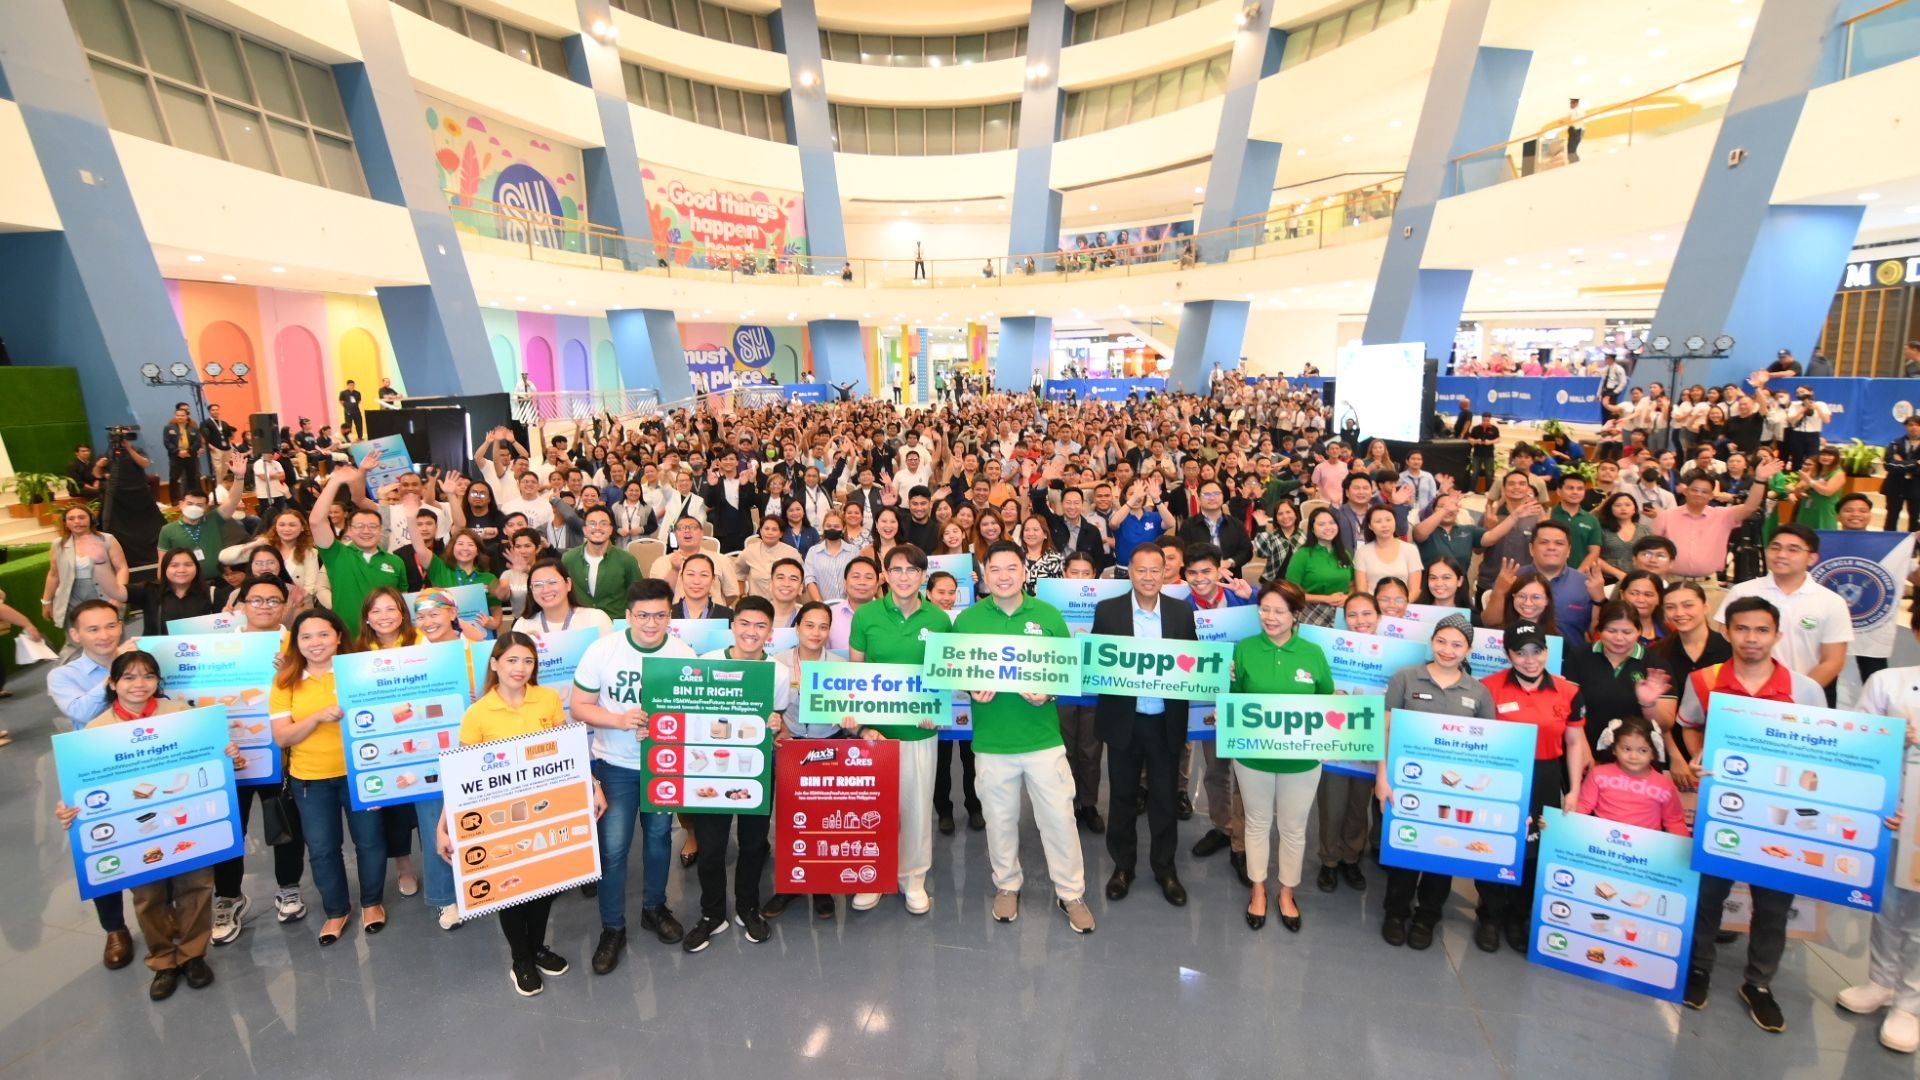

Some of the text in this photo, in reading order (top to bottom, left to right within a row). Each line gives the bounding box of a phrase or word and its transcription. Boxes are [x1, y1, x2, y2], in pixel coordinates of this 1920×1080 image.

[668, 180, 779, 223] Good things
[690, 209, 759, 241] happen
[1205, 632, 1227, 640] right!
[1516, 625, 1536, 635] KFC
[942, 646, 1079, 666] Be the Solution
[1083, 642, 1092, 665] I
[1471, 652, 1485, 661] Bin
[1487, 653, 1494, 661] it
[179, 663, 196, 672] Bin
[539, 657, 563, 668] right!
[1333, 656, 1348, 665] Bin
[1357, 662, 1383, 671] right!
[376, 673, 428, 687] Bin it right!
[616, 670, 642, 687] SP
[926, 662, 1070, 684] Join the Mission
[812, 672, 819, 691] I
[823, 676, 869, 692] care
[871, 673, 903, 692] for
[1082, 675, 1220, 694] #SMWasteFreeFuture
[608, 686, 642, 704] HA
[673, 686, 743, 697] BIN IT RIGHT!
[809, 694, 943, 715] Environment
[1226, 702, 1234, 728] I
[1442, 723, 1464, 732] KFC
[131, 734, 159, 744] CARES
[1227, 738, 1375, 752] #SMWasteFreeFuture
[1434, 737, 1451, 746] Bin
[1461, 741, 1488, 751] right!
[1765, 728, 1838, 747] Bin it right!
[114, 742, 178, 762] Bin it right!
[481, 760, 511, 772] CARES
[844, 758, 873, 766] CARES
[461, 780, 484, 795] WE
[489, 773, 512, 789] BIN
[516, 769, 528, 782] IT
[533, 758, 575, 778] RIGHT!
[800, 776, 875, 787] BIN IT RIGHT!
[1594, 774, 1672, 802] adidas
[1588, 845, 1606, 856] Bin
[1607, 849, 1616, 858] it
[1617, 853, 1648, 865] right!
